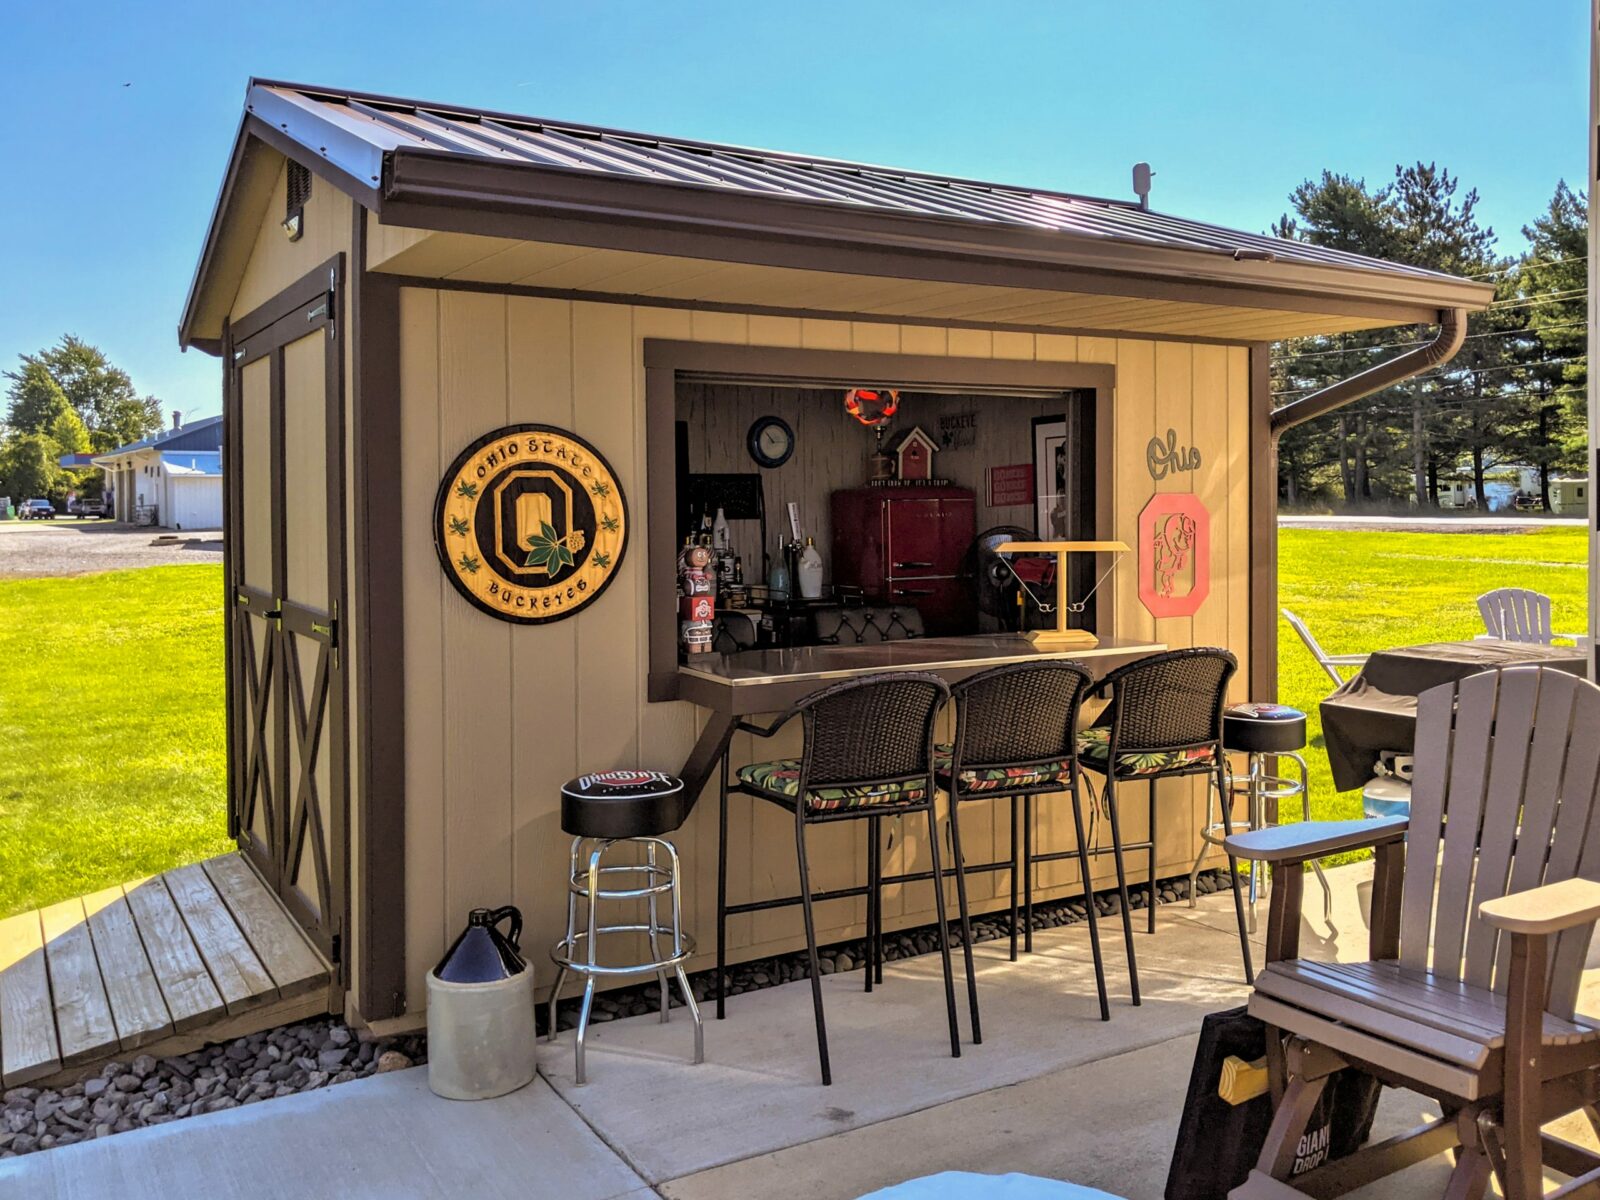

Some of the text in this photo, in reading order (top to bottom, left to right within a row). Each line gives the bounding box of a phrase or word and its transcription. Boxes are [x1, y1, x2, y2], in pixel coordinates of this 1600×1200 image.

[476, 439, 592, 478] OHIO STATE
[1146, 428, 1202, 481] Ohio
[488, 578, 587, 609] BUCKEYES
[1293, 1150, 1324, 1175] DROP
